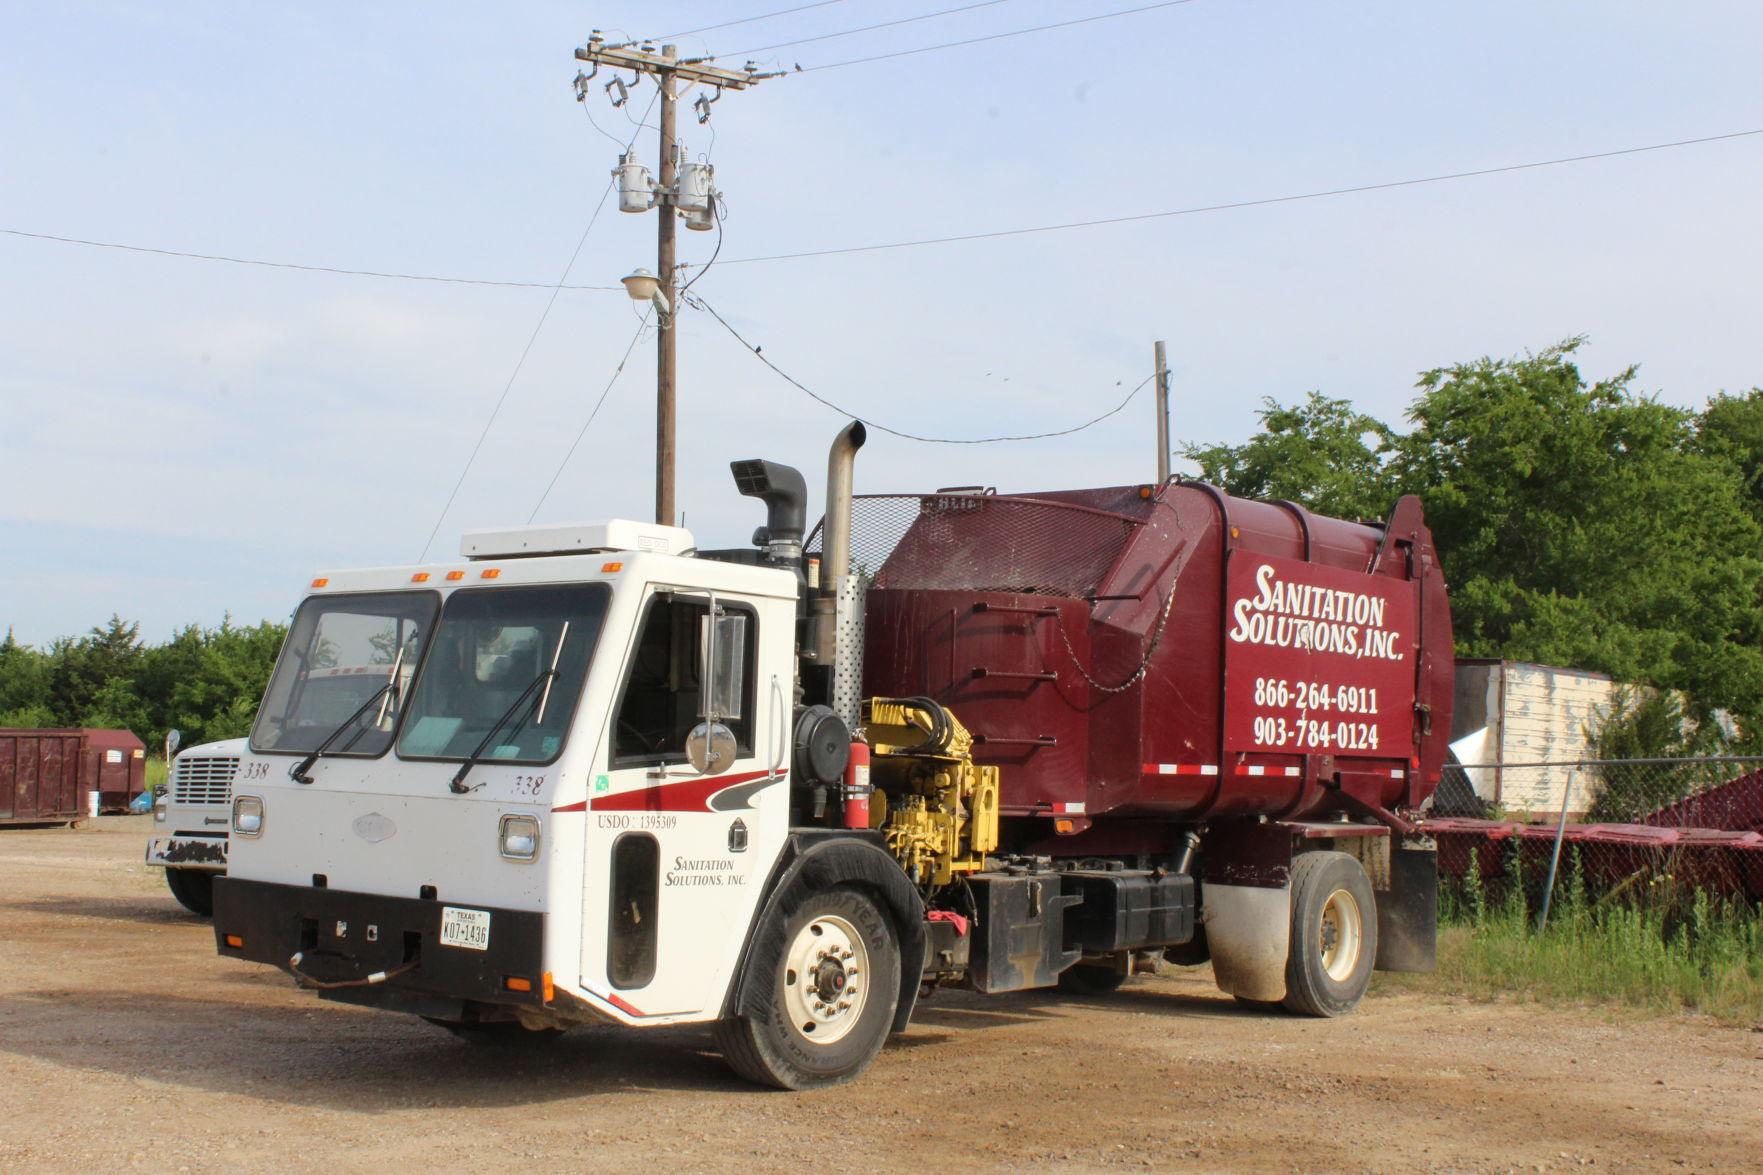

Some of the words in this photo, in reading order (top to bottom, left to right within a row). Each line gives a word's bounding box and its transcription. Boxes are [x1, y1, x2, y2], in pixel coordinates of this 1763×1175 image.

[1253, 564, 1385, 627] SANITATION
[1254, 677, 1378, 714] 866-264-6911
[1254, 716, 1378, 750] 903-784-0124
[244, 762, 270, 779] 338
[641, 815, 677, 829] 1395309
[674, 856, 734, 871] SANITATION
[665, 872, 724, 887] SOLUTIONS,
[728, 875, 746, 886] INC.
[457, 912, 476, 920] TEXAS
